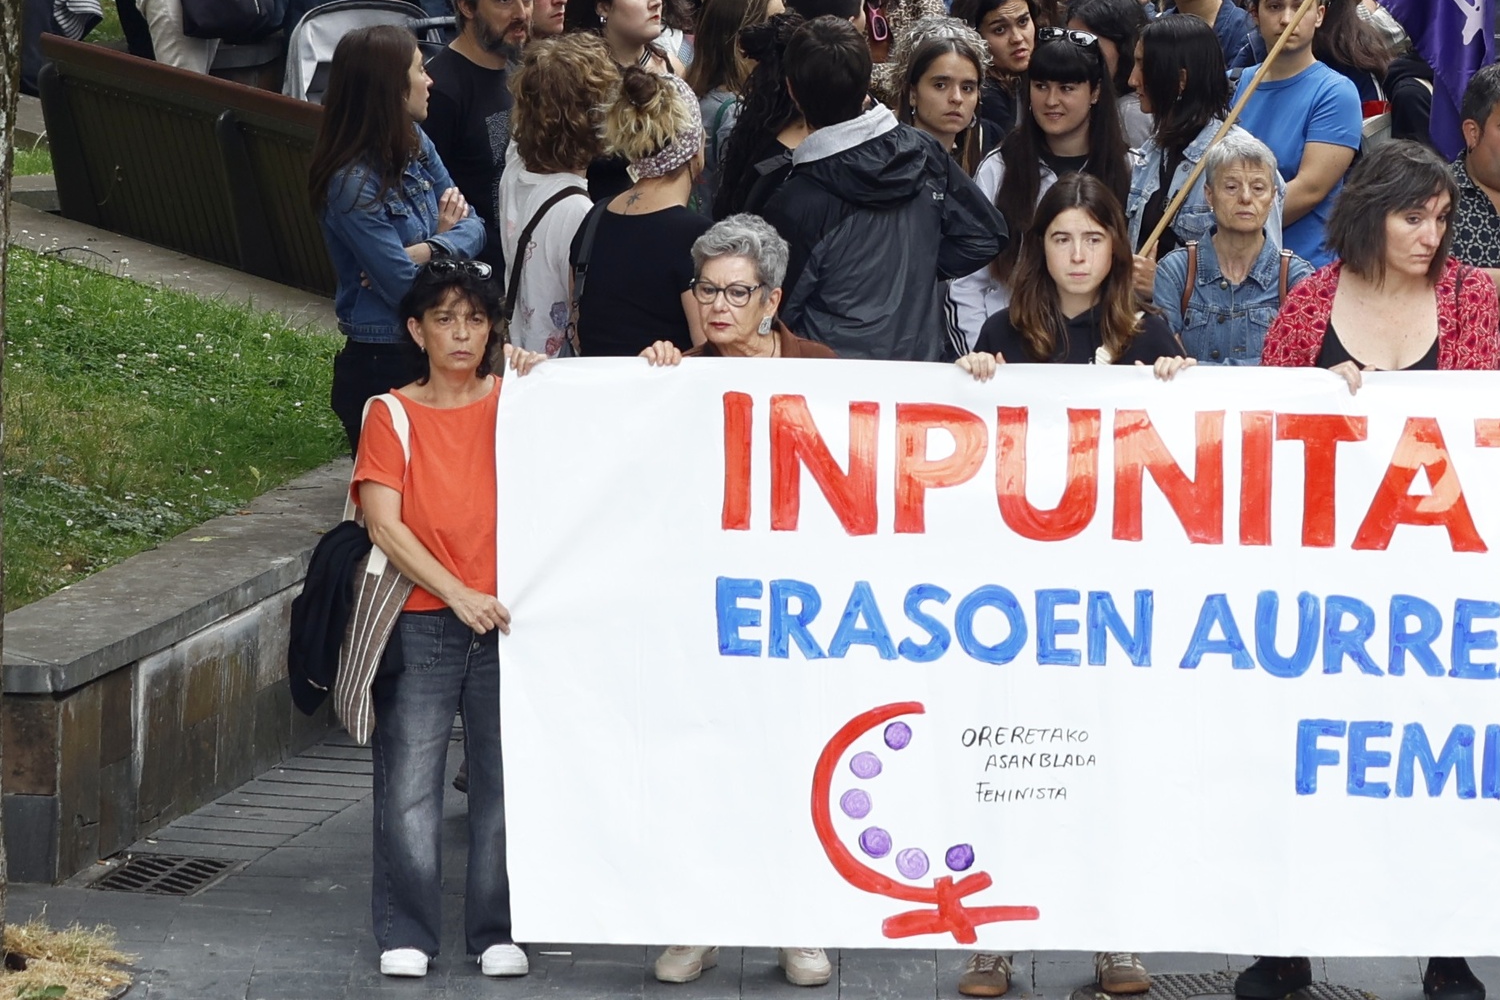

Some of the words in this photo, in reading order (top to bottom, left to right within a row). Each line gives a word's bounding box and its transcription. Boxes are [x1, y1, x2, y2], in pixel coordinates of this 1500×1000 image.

[715, 576, 1154, 667] ERASOEN
[961, 725, 1089, 748] ORERETAKO
[984, 752, 1096, 772] ASANBLADA
